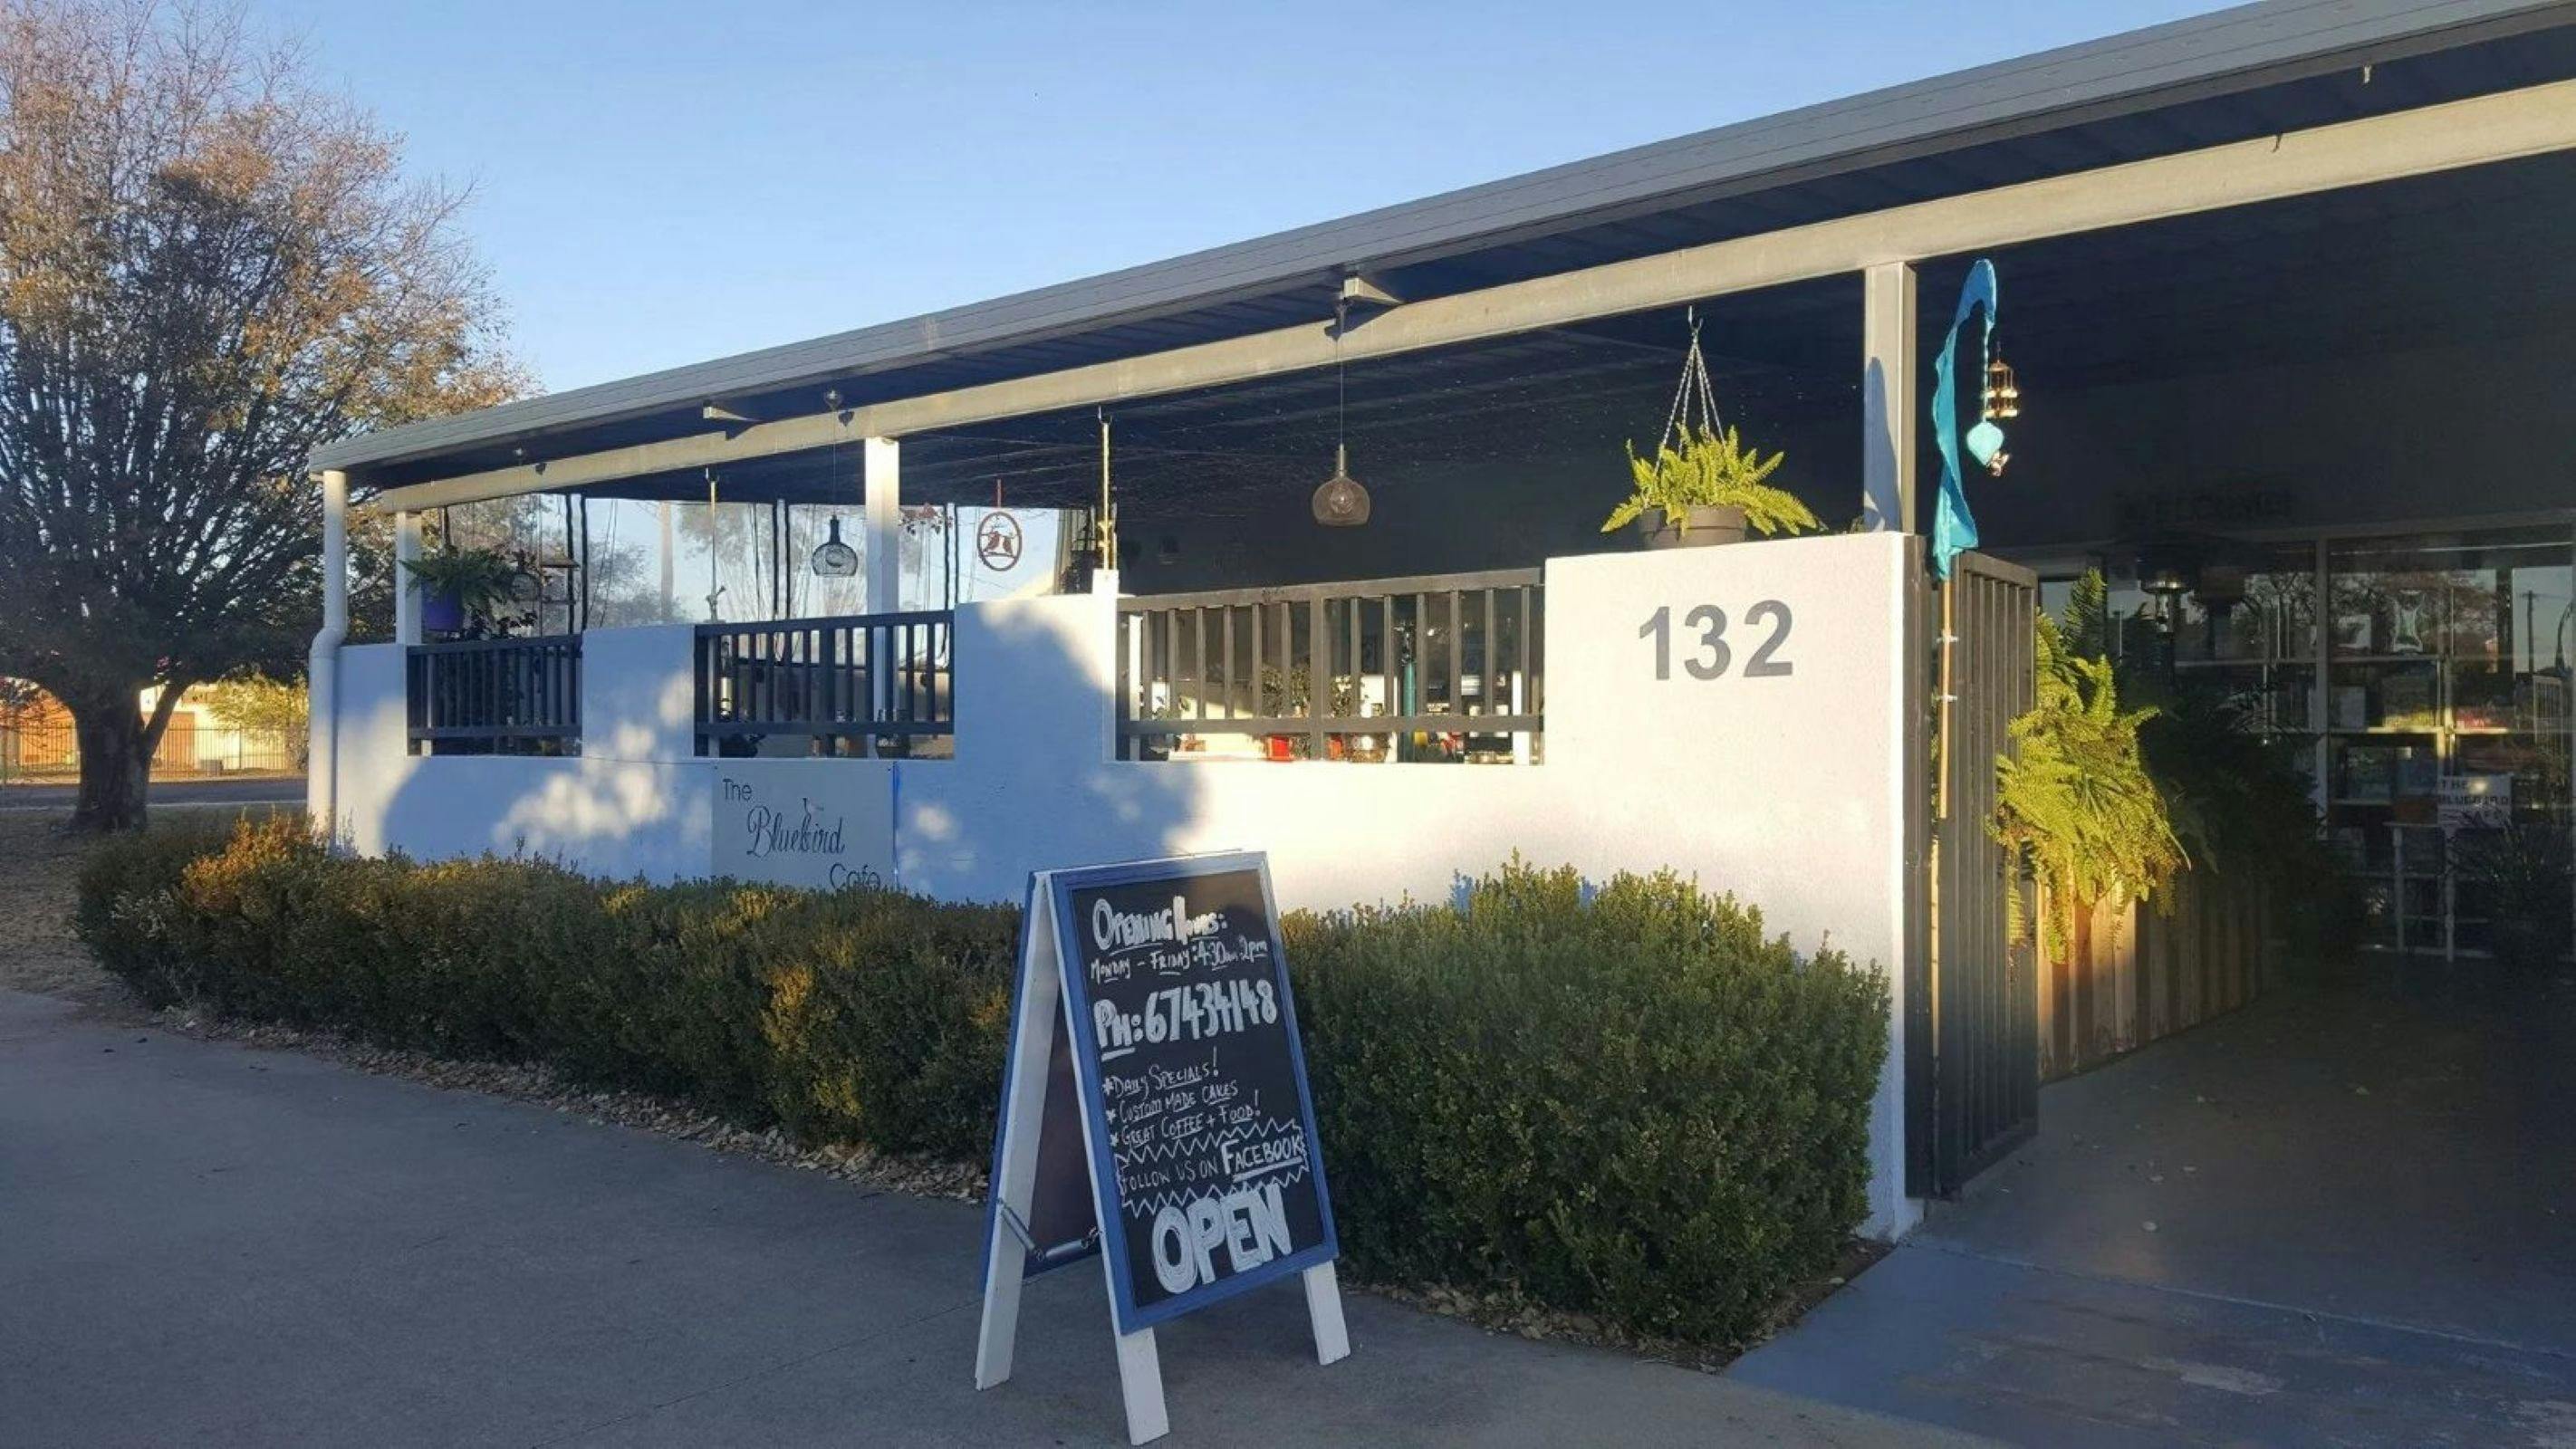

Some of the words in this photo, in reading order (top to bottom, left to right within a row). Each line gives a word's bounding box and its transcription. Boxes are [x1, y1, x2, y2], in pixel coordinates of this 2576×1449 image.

[1639, 600, 1793, 680] 132
[722, 778, 754, 801] The
[745, 804, 846, 859] Bluebird
[1176, 1160, 1196, 1182] US
[1198, 1156, 1219, 1178] ON
[1221, 1134, 1302, 1176] FACEBOOK
[1151, 1183, 1293, 1294] OPEN
